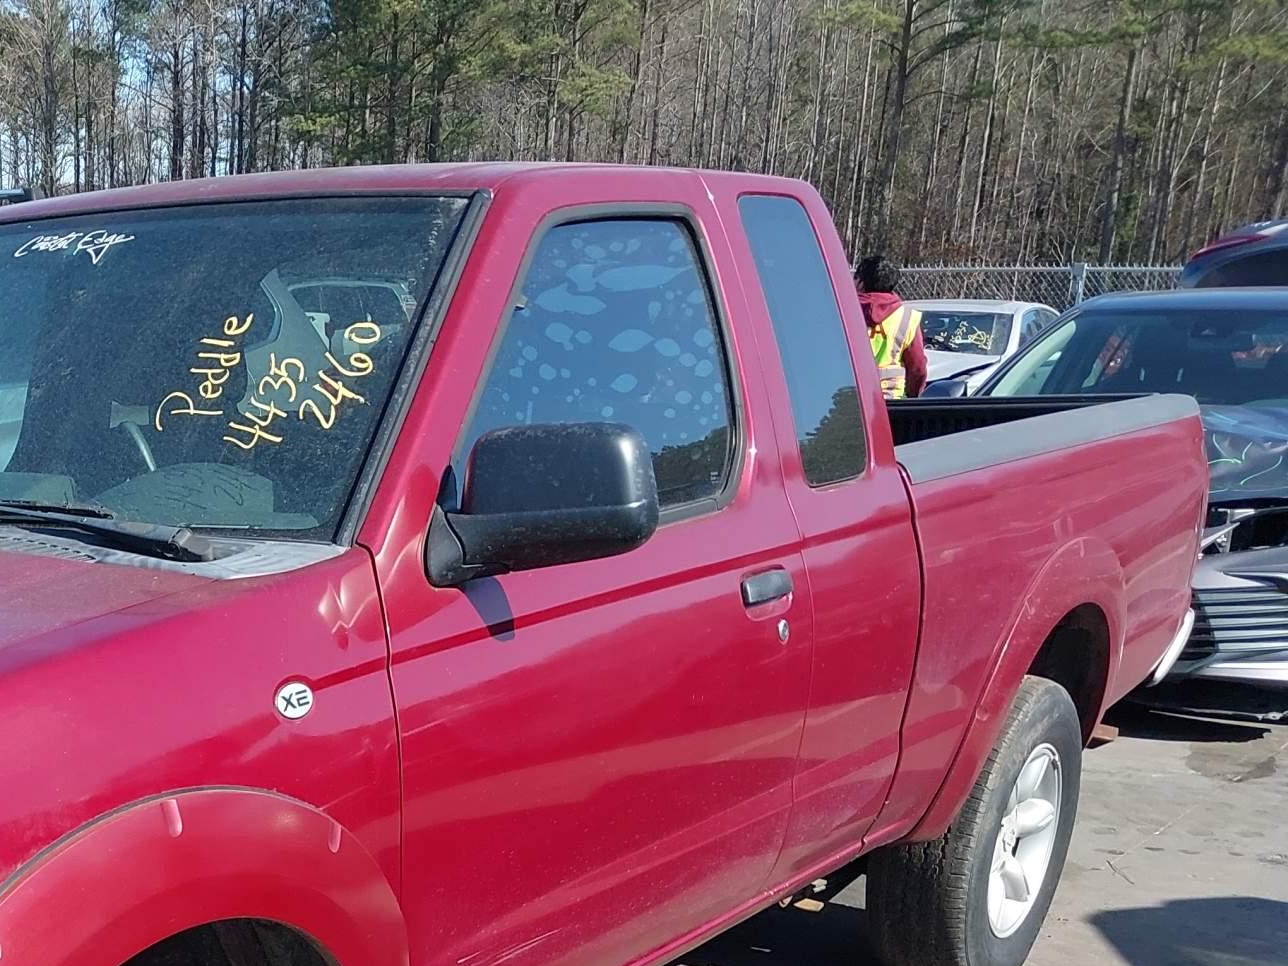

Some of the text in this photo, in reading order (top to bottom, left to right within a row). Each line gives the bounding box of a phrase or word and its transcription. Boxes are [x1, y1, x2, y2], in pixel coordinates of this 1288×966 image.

[73, 230, 135, 264] Edge
[155, 313, 254, 431] Peddle
[223, 353, 305, 449] 4435
[299, 321, 381, 429] 2460
[281, 689, 310, 712] XE
